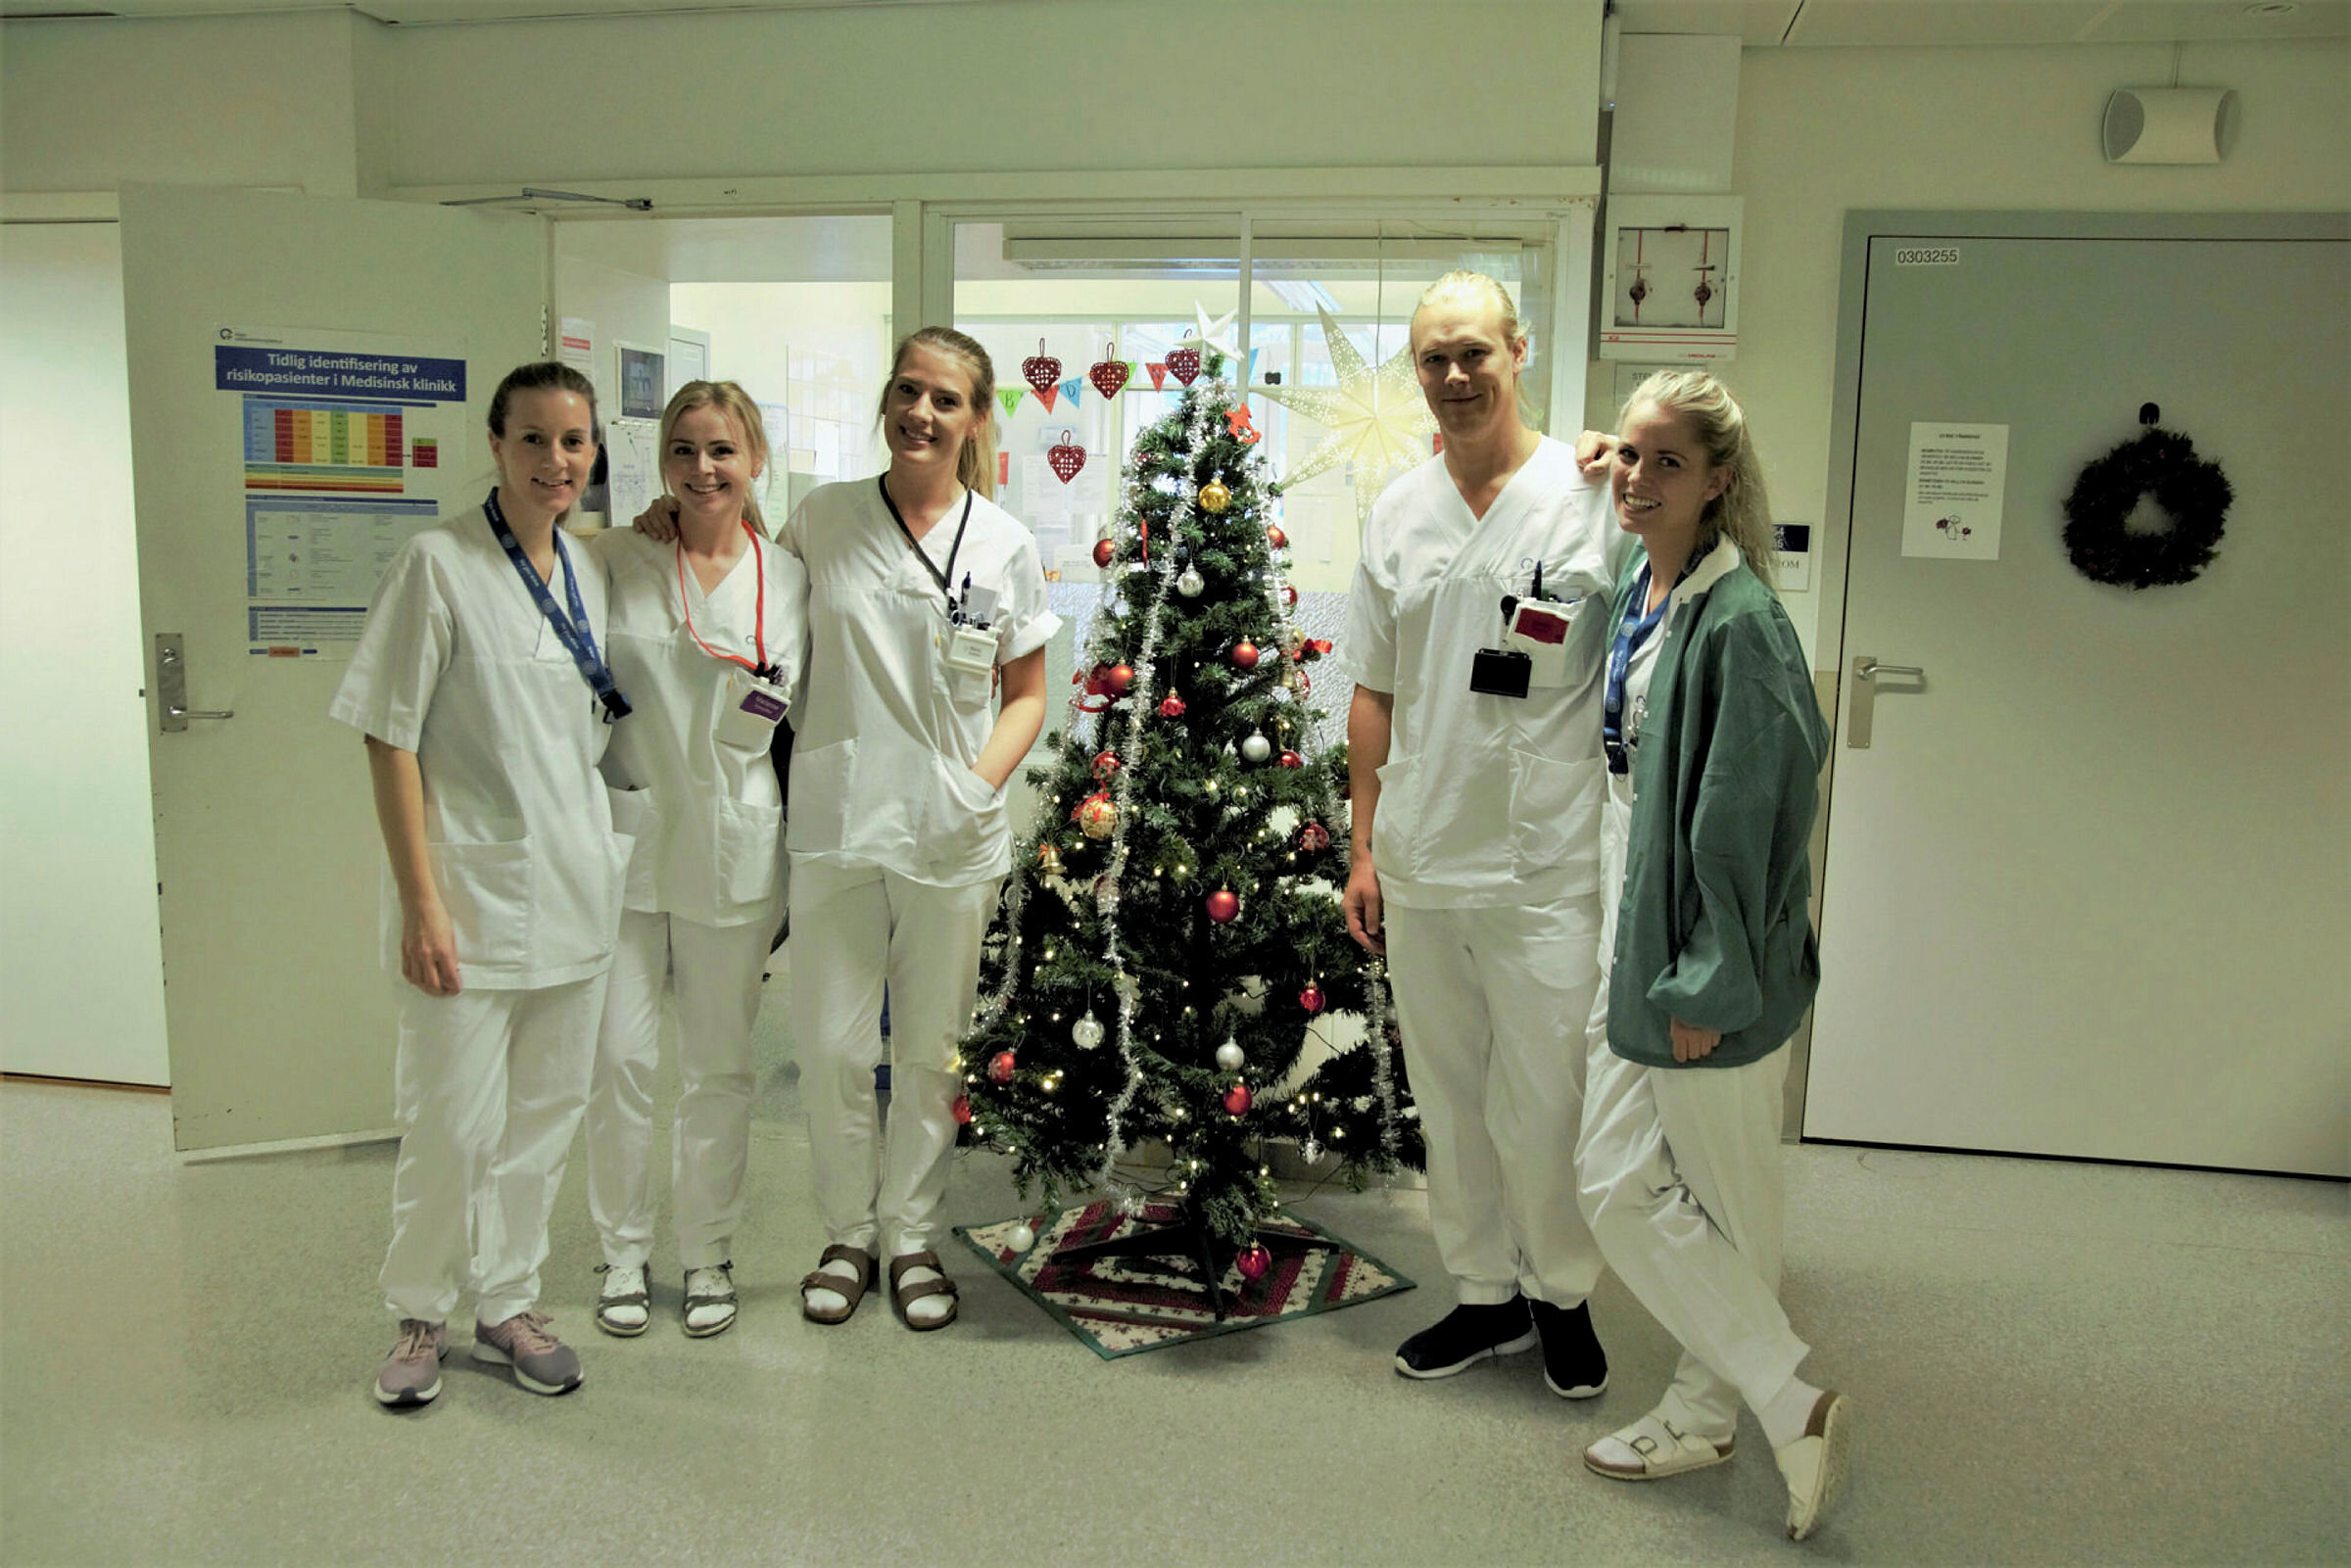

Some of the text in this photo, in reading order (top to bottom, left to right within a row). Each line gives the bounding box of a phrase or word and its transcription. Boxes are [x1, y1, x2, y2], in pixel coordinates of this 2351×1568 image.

[1897, 250, 1957, 263] 0303255
[267, 354, 306, 369] Tidlig
[309, 356, 399, 375] identifisering
[226, 368, 456, 392] risikopasienter i Medisinsk klinikk
